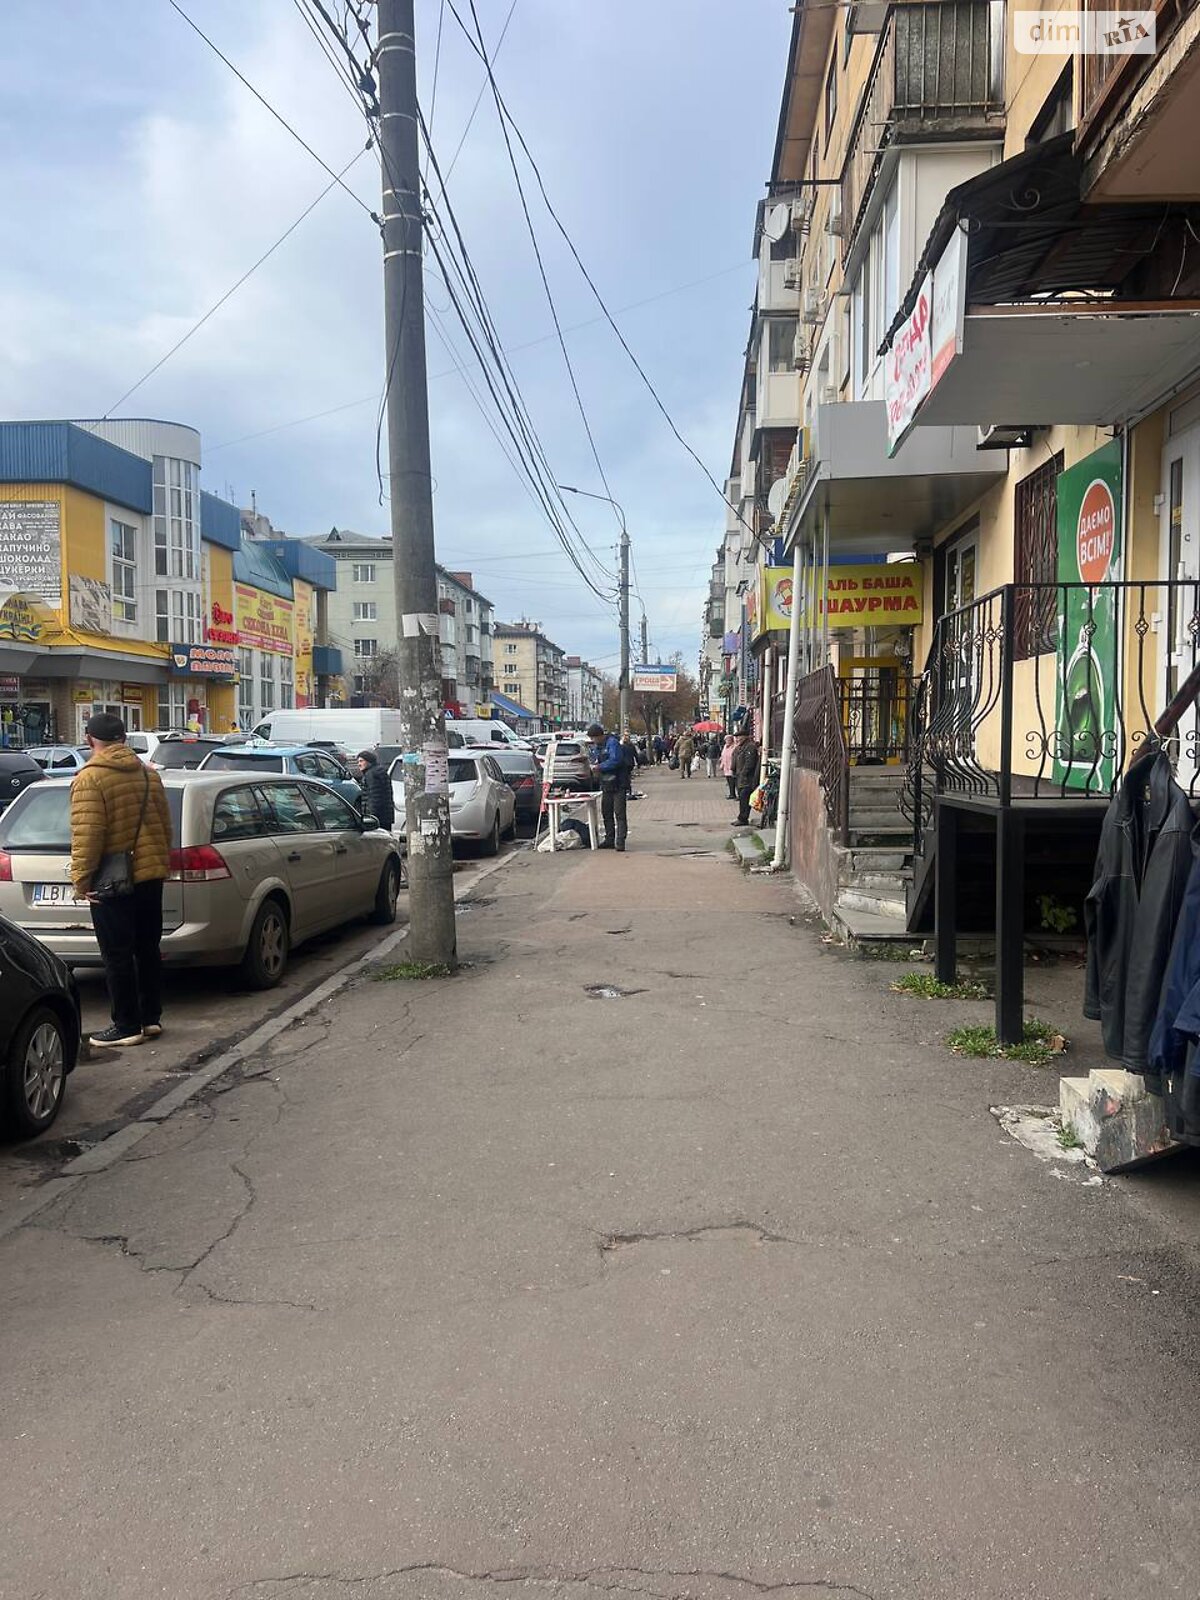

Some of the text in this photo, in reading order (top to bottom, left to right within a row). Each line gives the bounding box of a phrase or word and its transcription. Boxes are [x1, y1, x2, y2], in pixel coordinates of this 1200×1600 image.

[0, 510, 16, 520] АЙ
[1080, 506, 1110, 539] ДАЄМО
[1080, 530, 1112, 567] ВСІМ!
[862, 576, 913, 590] БАША
[819, 595, 919, 614] ШАУРМА
